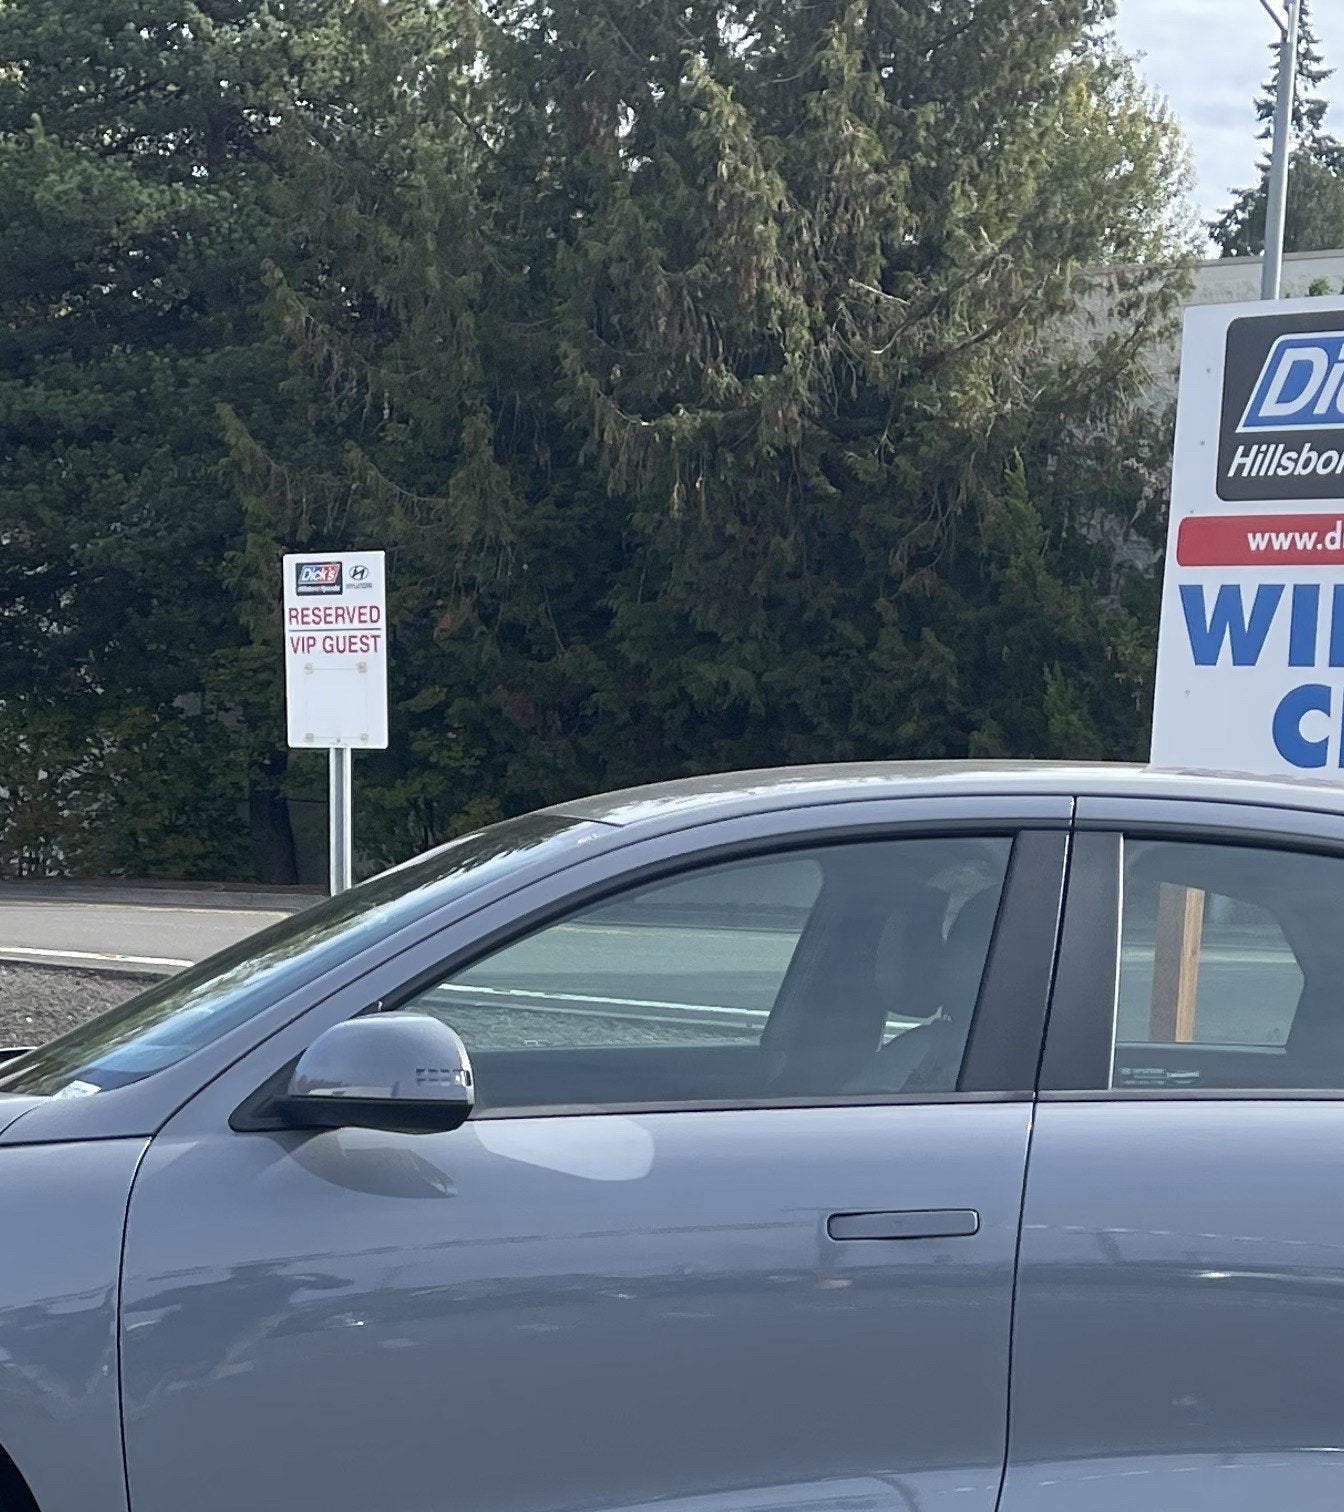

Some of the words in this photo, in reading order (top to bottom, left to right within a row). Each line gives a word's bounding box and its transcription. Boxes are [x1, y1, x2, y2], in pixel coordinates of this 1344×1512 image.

[288, 605, 381, 625] RESERVED
[290, 636, 316, 654] VIP
[322, 634, 381, 654] GUEST
